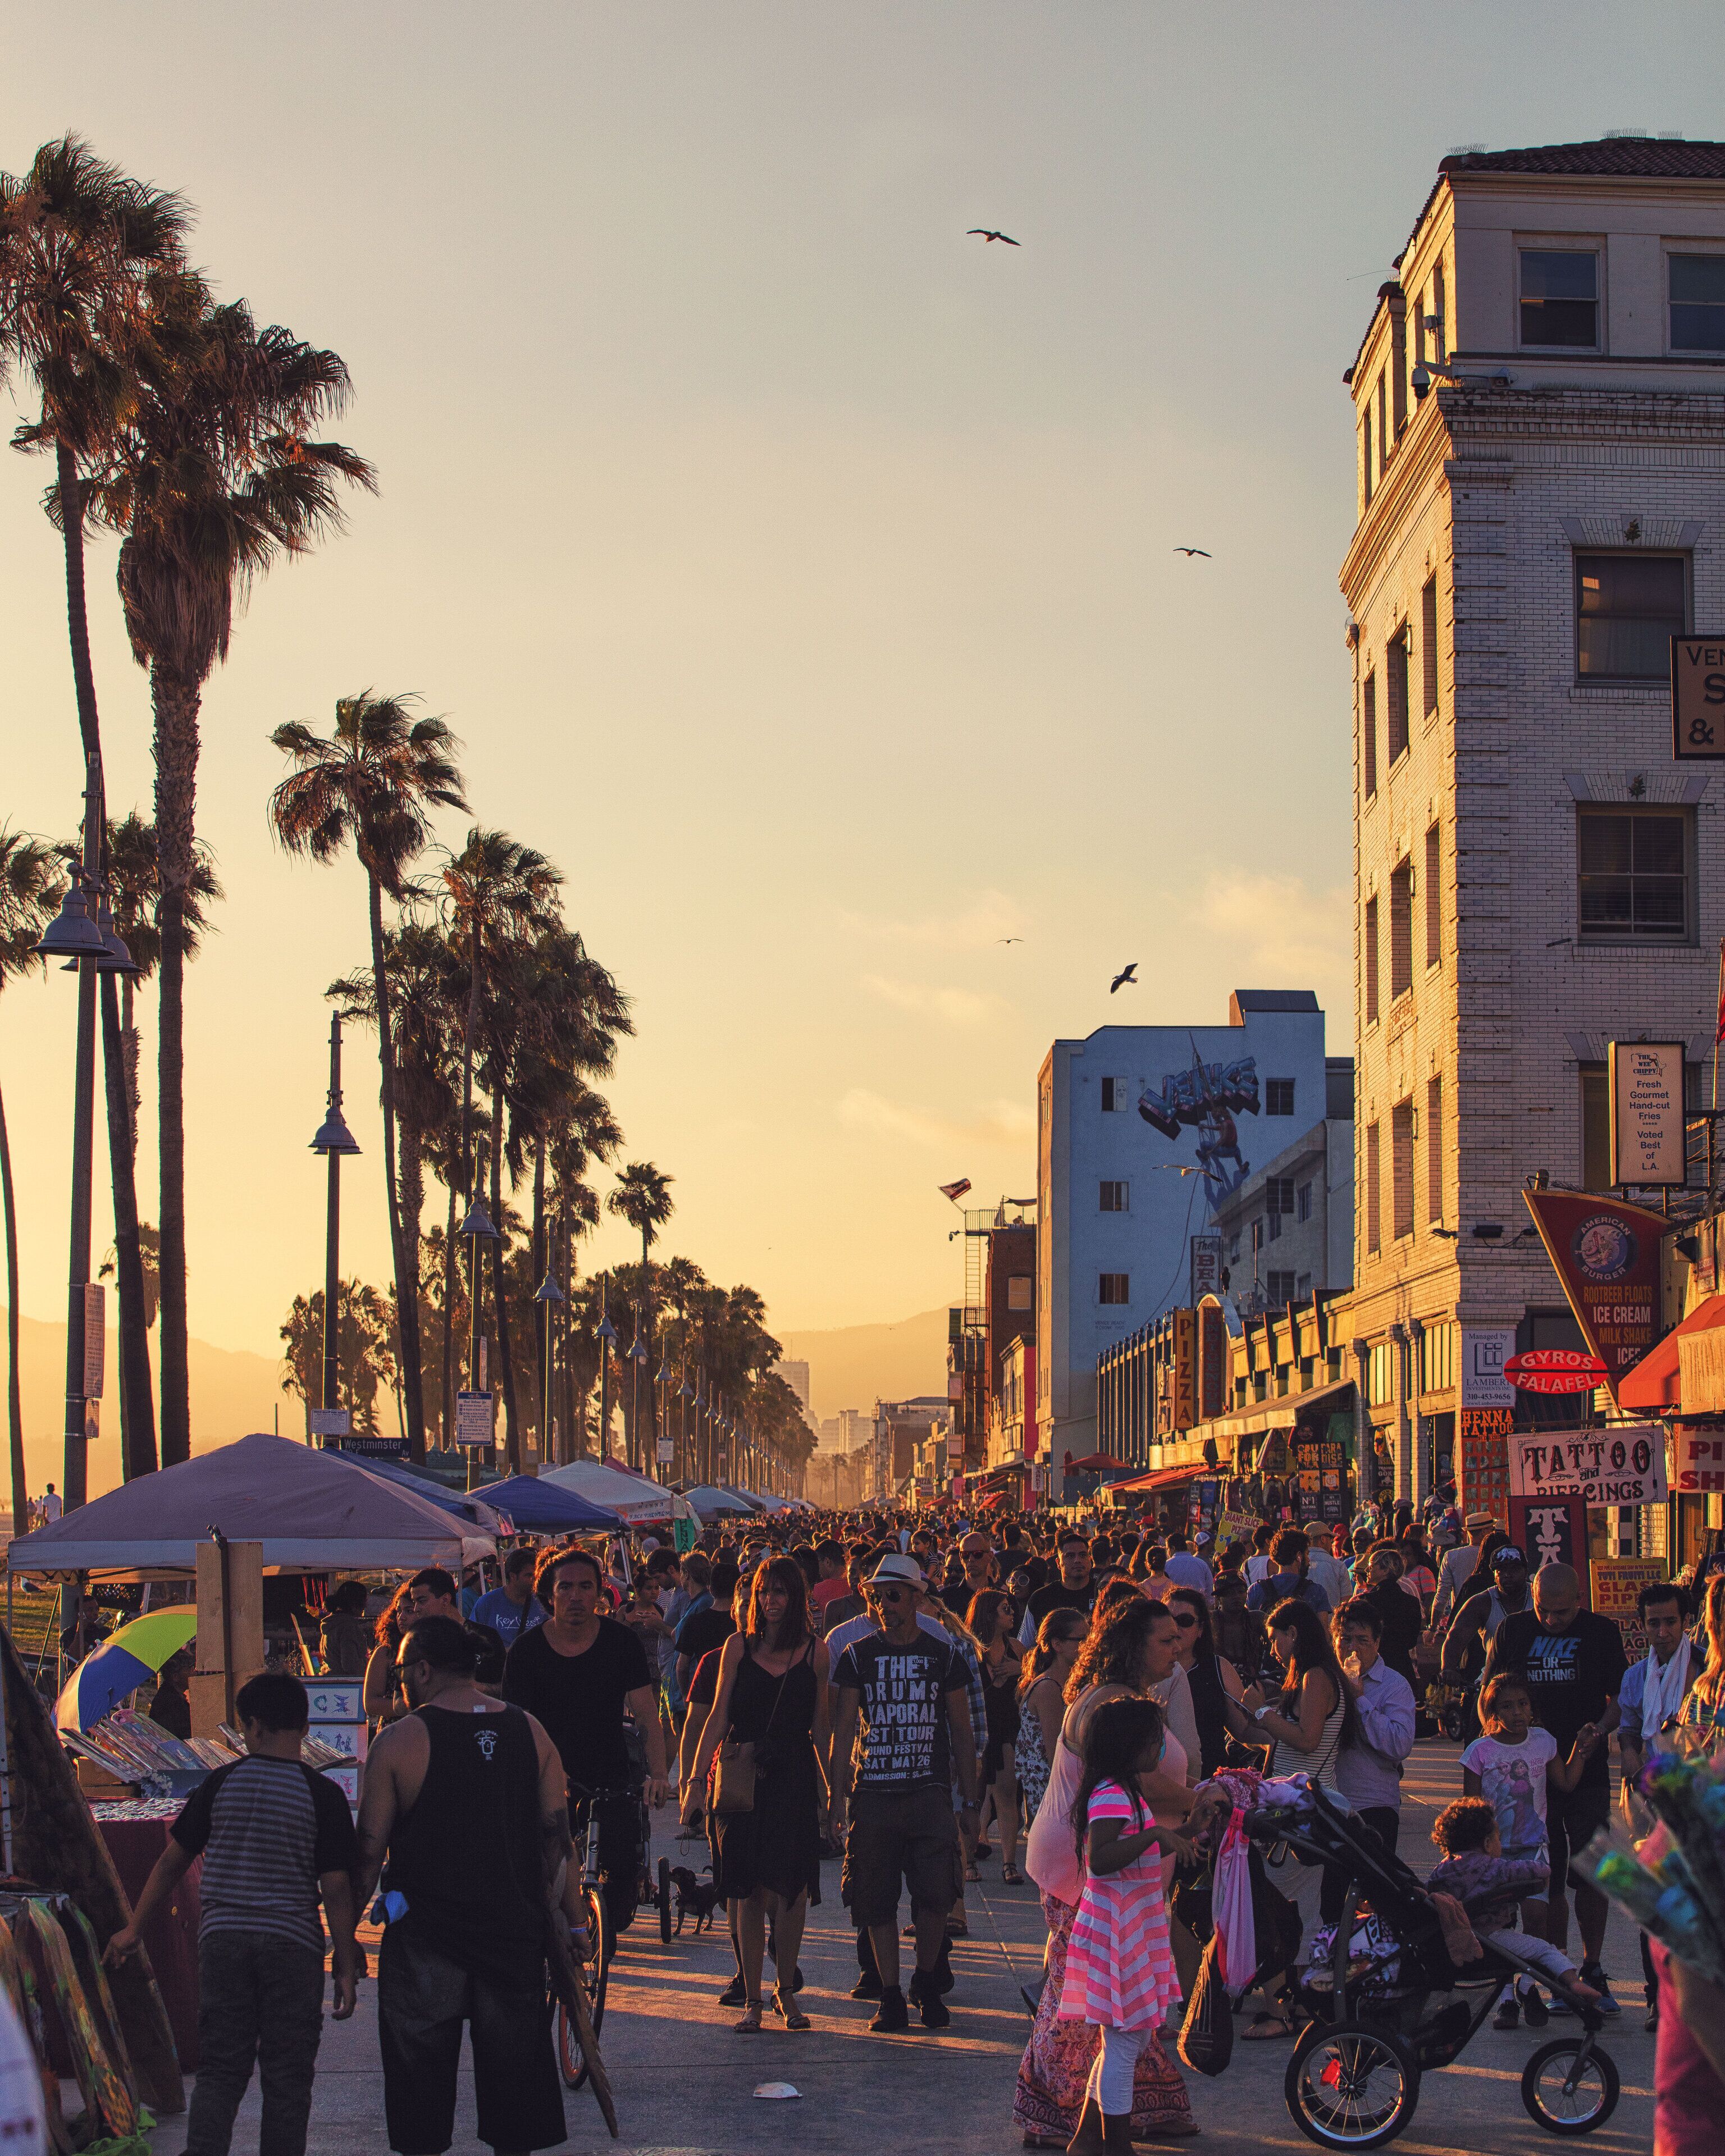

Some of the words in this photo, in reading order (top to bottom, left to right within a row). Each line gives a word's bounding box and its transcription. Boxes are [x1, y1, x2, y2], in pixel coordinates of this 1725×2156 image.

[1581, 1217, 1631, 1236] AMERICAN
[1197, 1241, 1212, 1251] The
[1581, 1266, 1626, 1280] BURGER
[1583, 1286, 1622, 1303] ROOTBEER
[1624, 1285, 1652, 1303] FLOATS
[1593, 1307, 1610, 1323] ICE
[1613, 1307, 1651, 1323] CREAM
[1599, 1327, 1621, 1344] MILK
[1623, 1327, 1651, 1344] SHAKE
[1521, 1351, 1594, 1369] GYROS
[1179, 1319, 1192, 1422] PIZZA
[1516, 1372, 1596, 1392] FALAFEL
[1462, 1409, 1513, 1424] HENNA
[344, 1438, 402, 1450] Westminster
[1524, 1439, 1651, 1484] TATTOO
[1579, 1467, 1599, 1481] and
[1225, 1512, 1244, 1524] GIANT
[1244, 1516, 1260, 1528] SLICE
[1646, 1570, 1661, 1580] LLC
[1598, 1581, 1660, 1592] GLAS
[496, 1614, 515, 1630] Key
[1528, 1636, 1581, 1659] NIKE
[875, 1655, 919, 1679] THE
[1543, 1657, 1559, 1669] OR
[1527, 1668, 1576, 1682] NOTHING
[896, 1726, 935, 1742] TOUR
[865, 1757, 887, 1769] SAT
[917, 1755, 930, 1766] 26
